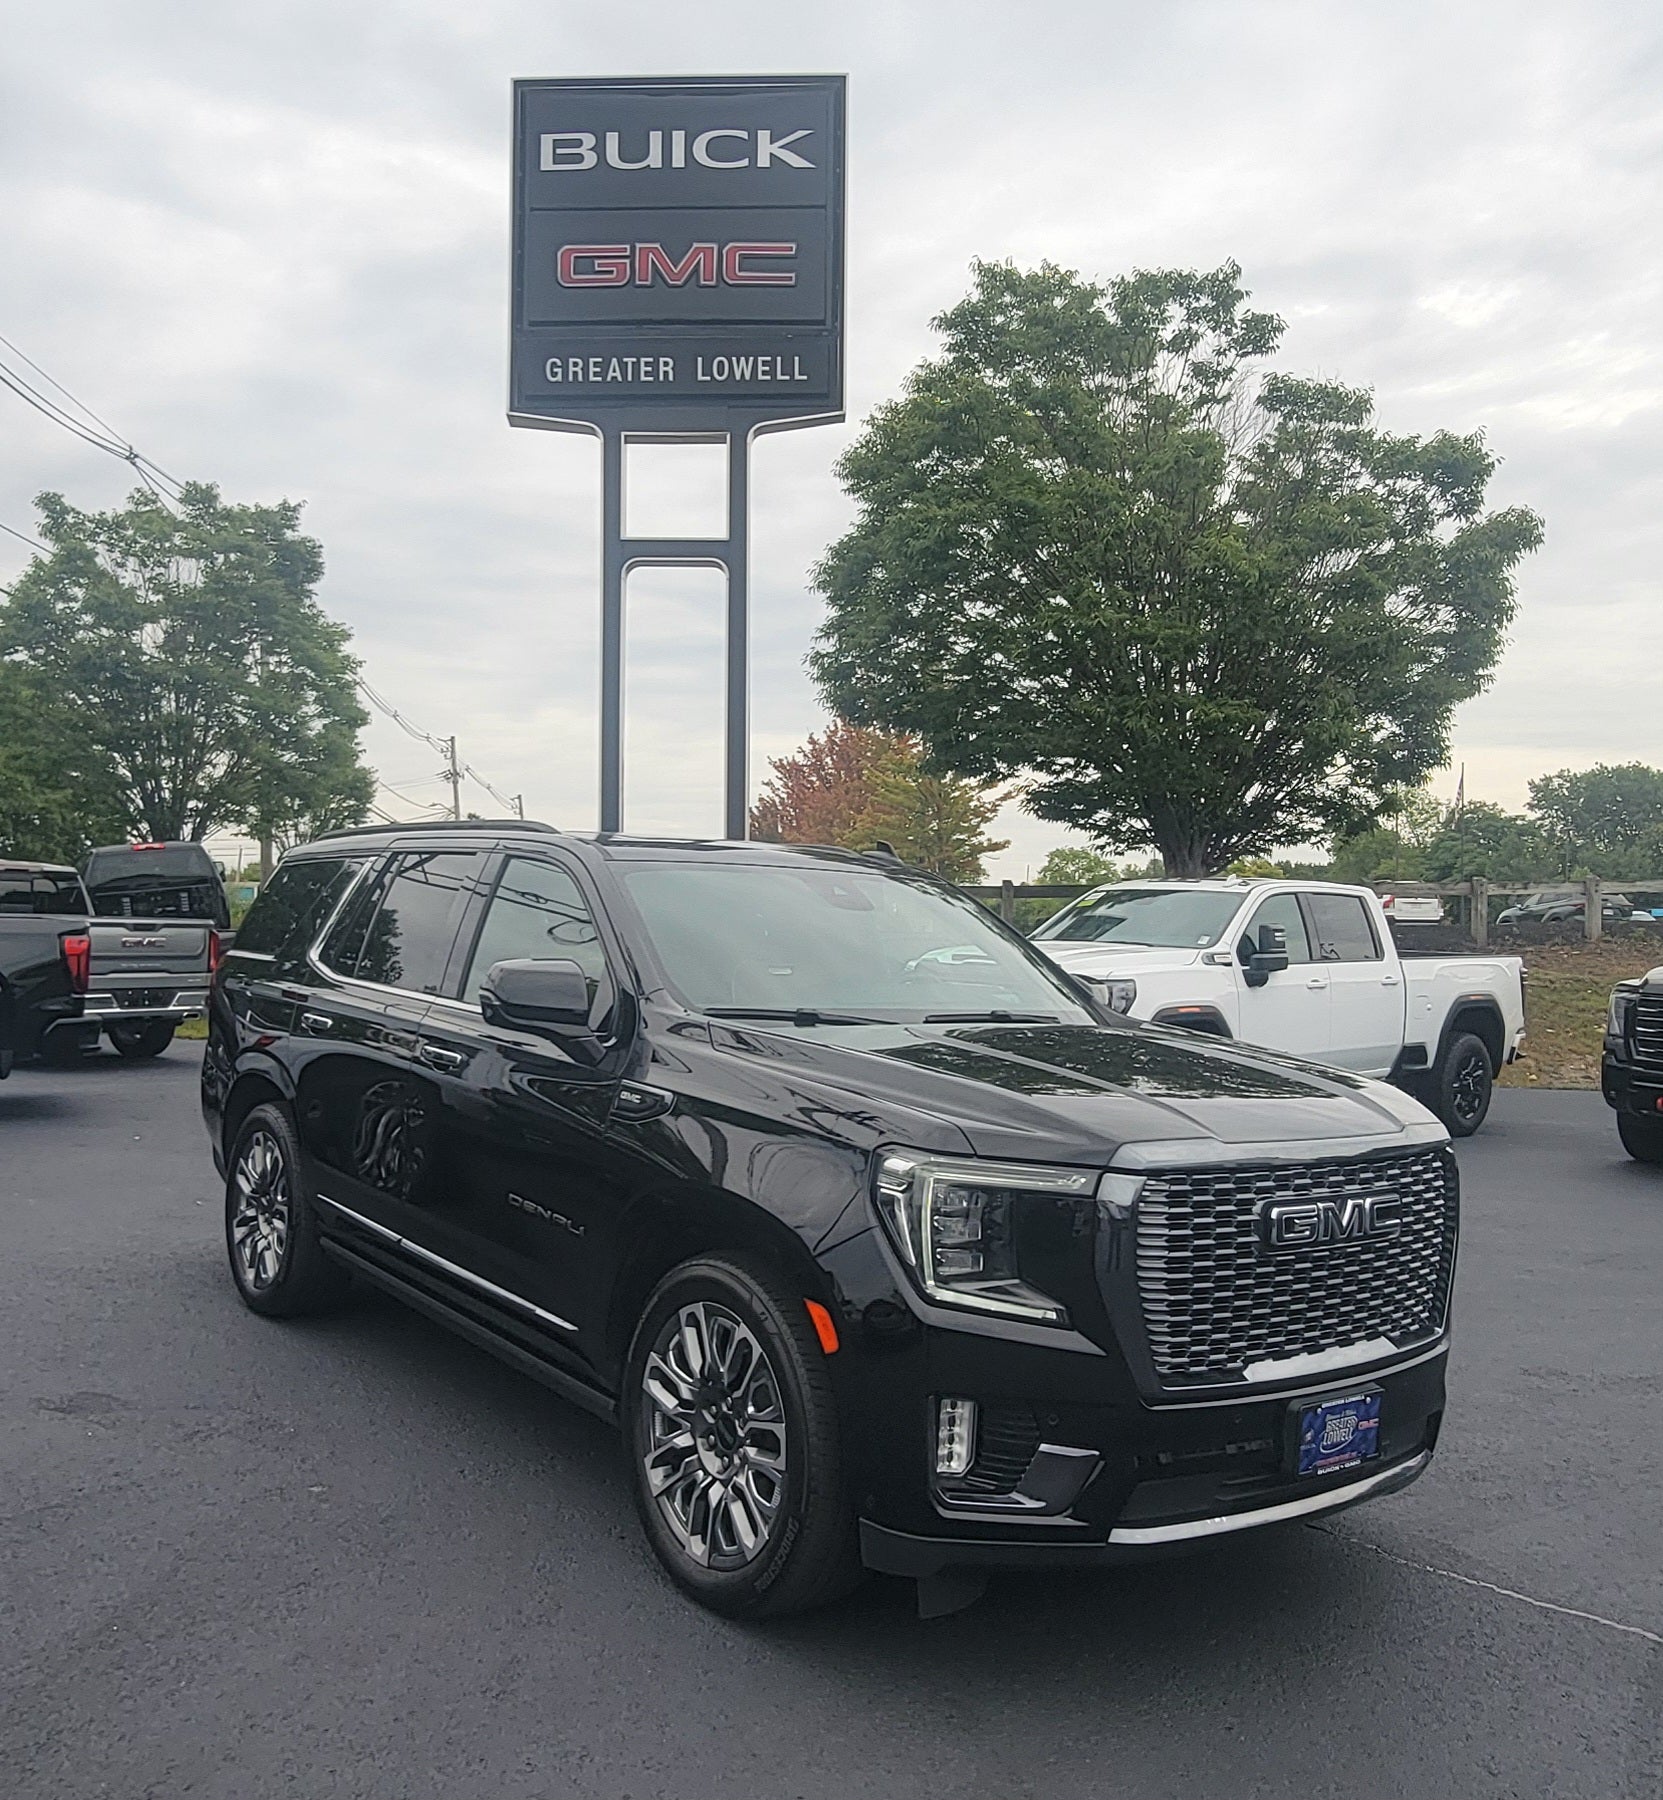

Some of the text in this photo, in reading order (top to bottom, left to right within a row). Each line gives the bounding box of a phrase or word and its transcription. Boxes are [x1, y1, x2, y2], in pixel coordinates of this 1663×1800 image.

[540, 129, 817, 171] BUICK
[557, 242, 797, 287] GMC
[545, 355, 808, 382] GREATER LOWELL
[121, 937, 167, 948] GMC
[620, 1091, 641, 1103] GMC
[1271, 1195, 1402, 1246] GMC
